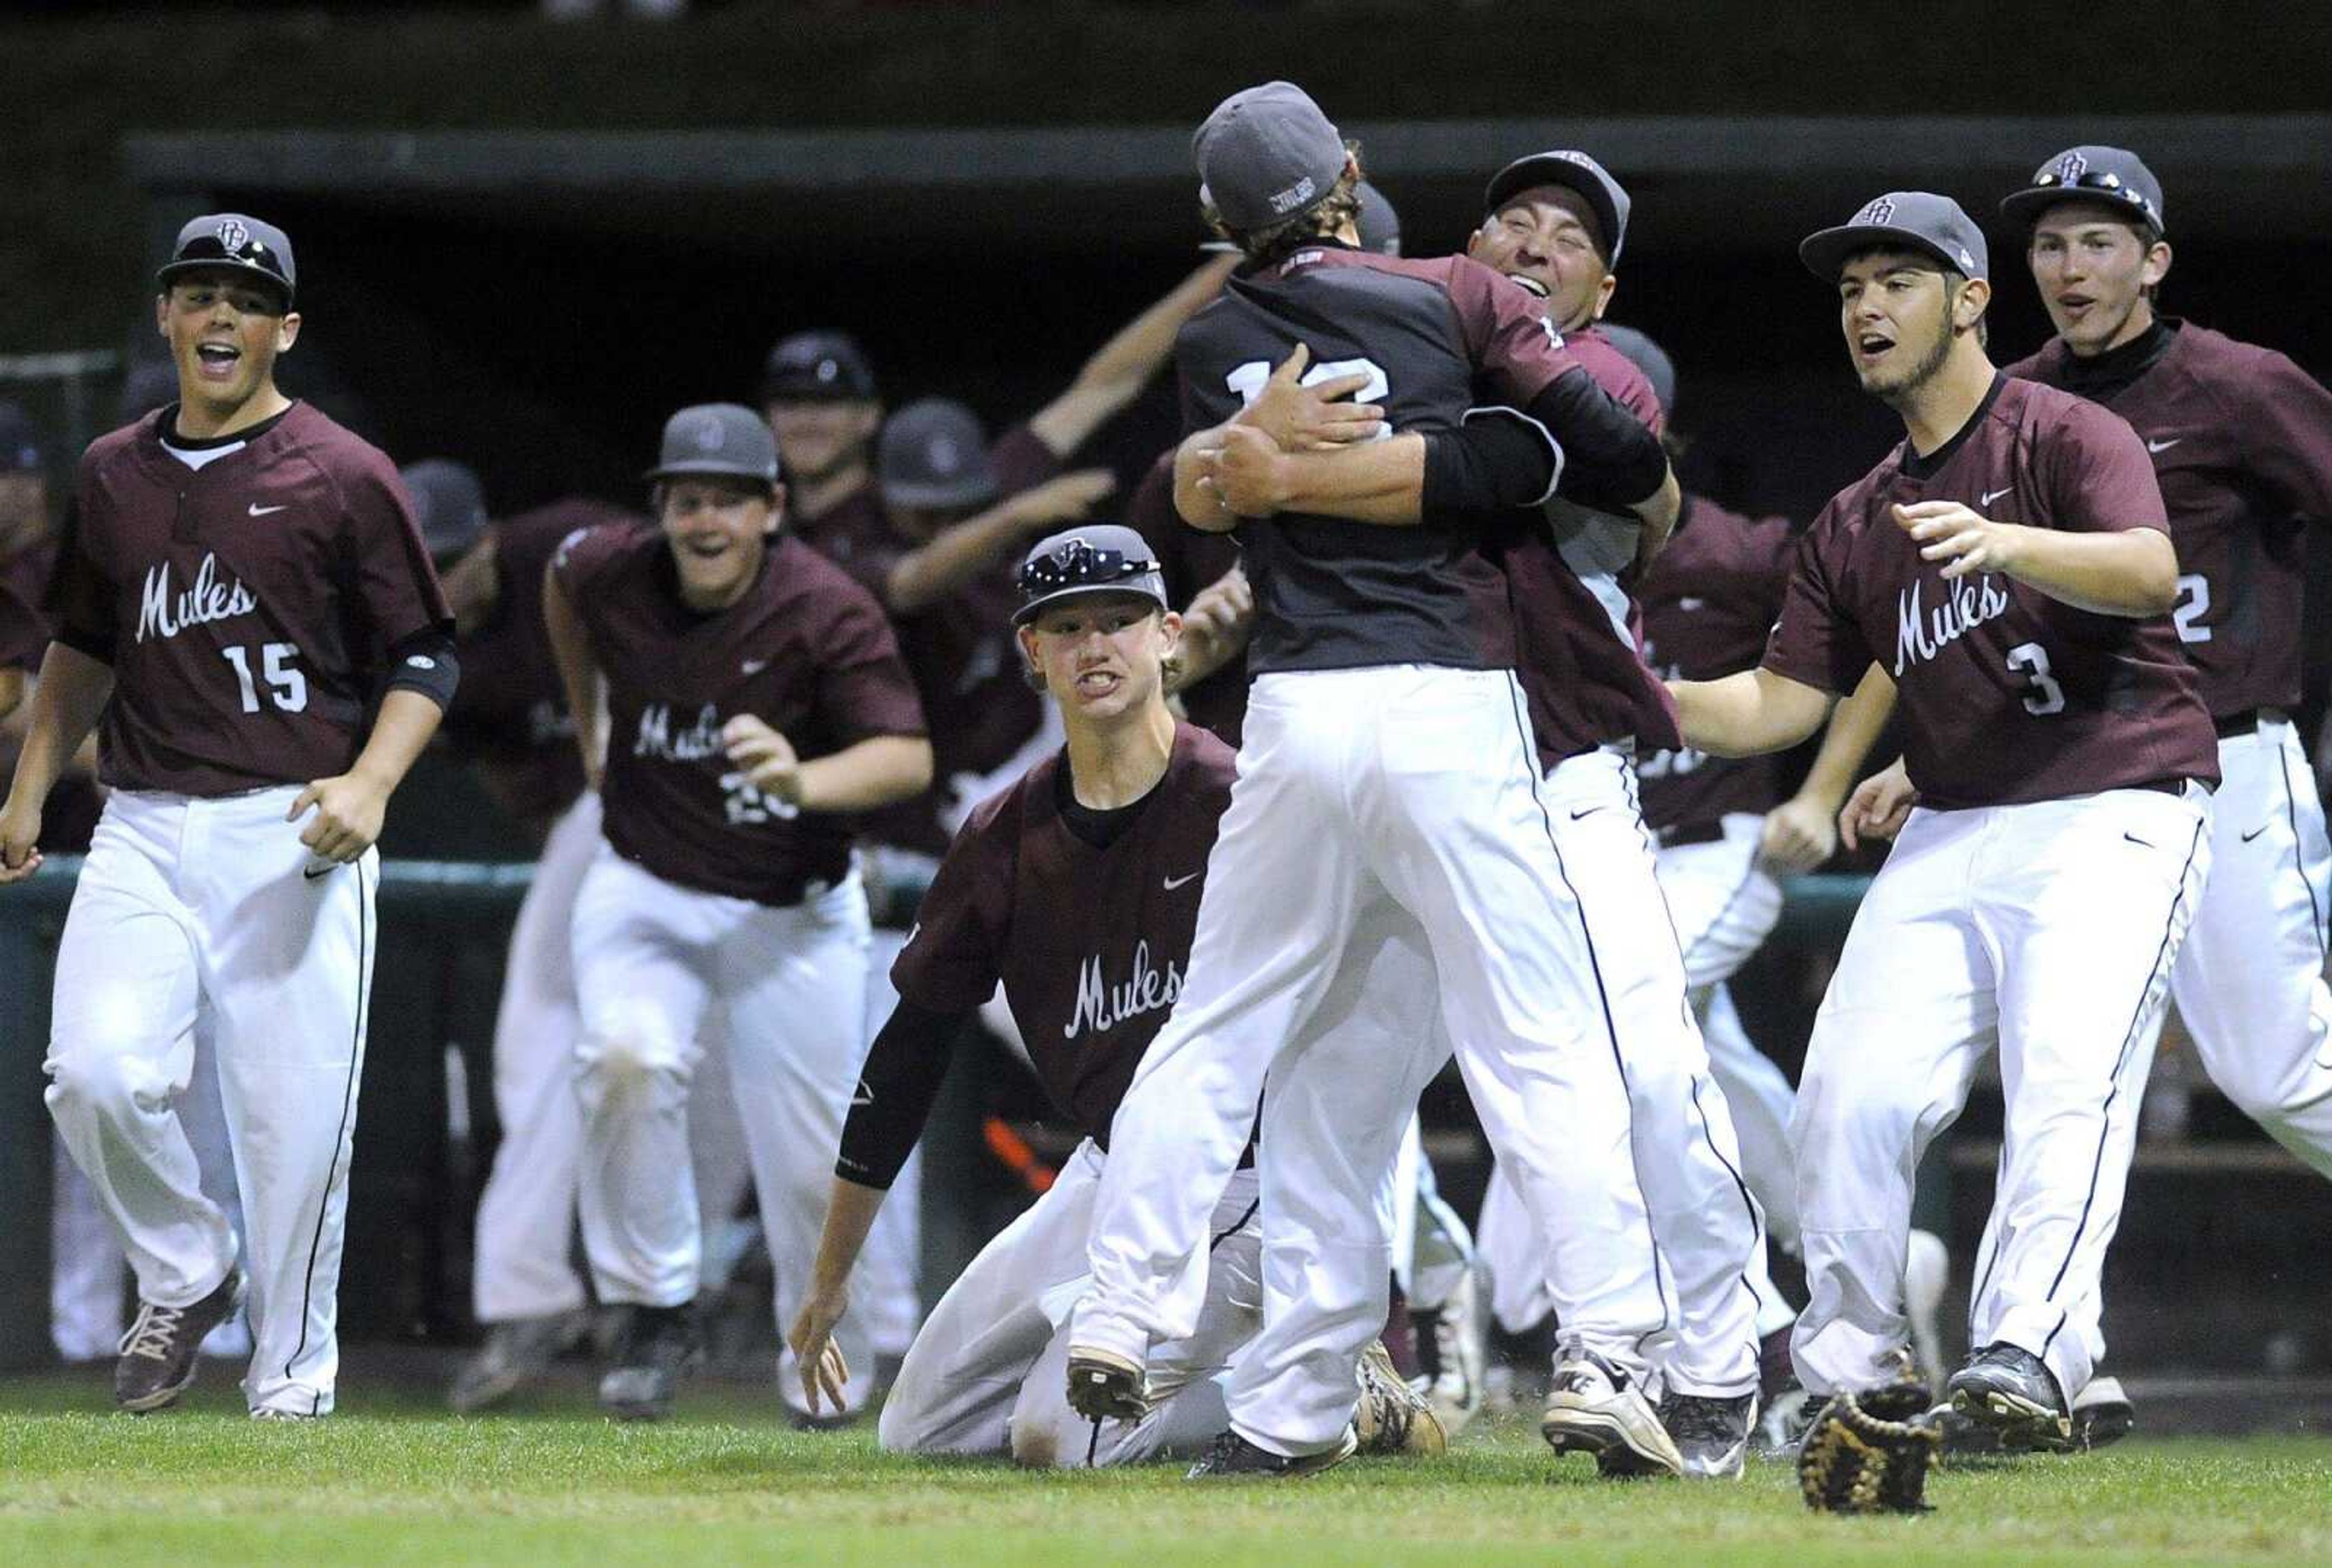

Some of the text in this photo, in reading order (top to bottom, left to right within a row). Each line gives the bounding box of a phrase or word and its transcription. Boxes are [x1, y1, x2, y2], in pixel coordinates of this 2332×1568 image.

[135, 551, 257, 644] Mules
[1894, 557, 2008, 677] Mules
[2173, 573, 2212, 643] 2
[222, 643, 308, 713] 15
[2006, 642, 2065, 715] 3
[1064, 939, 1183, 1039] Mules
